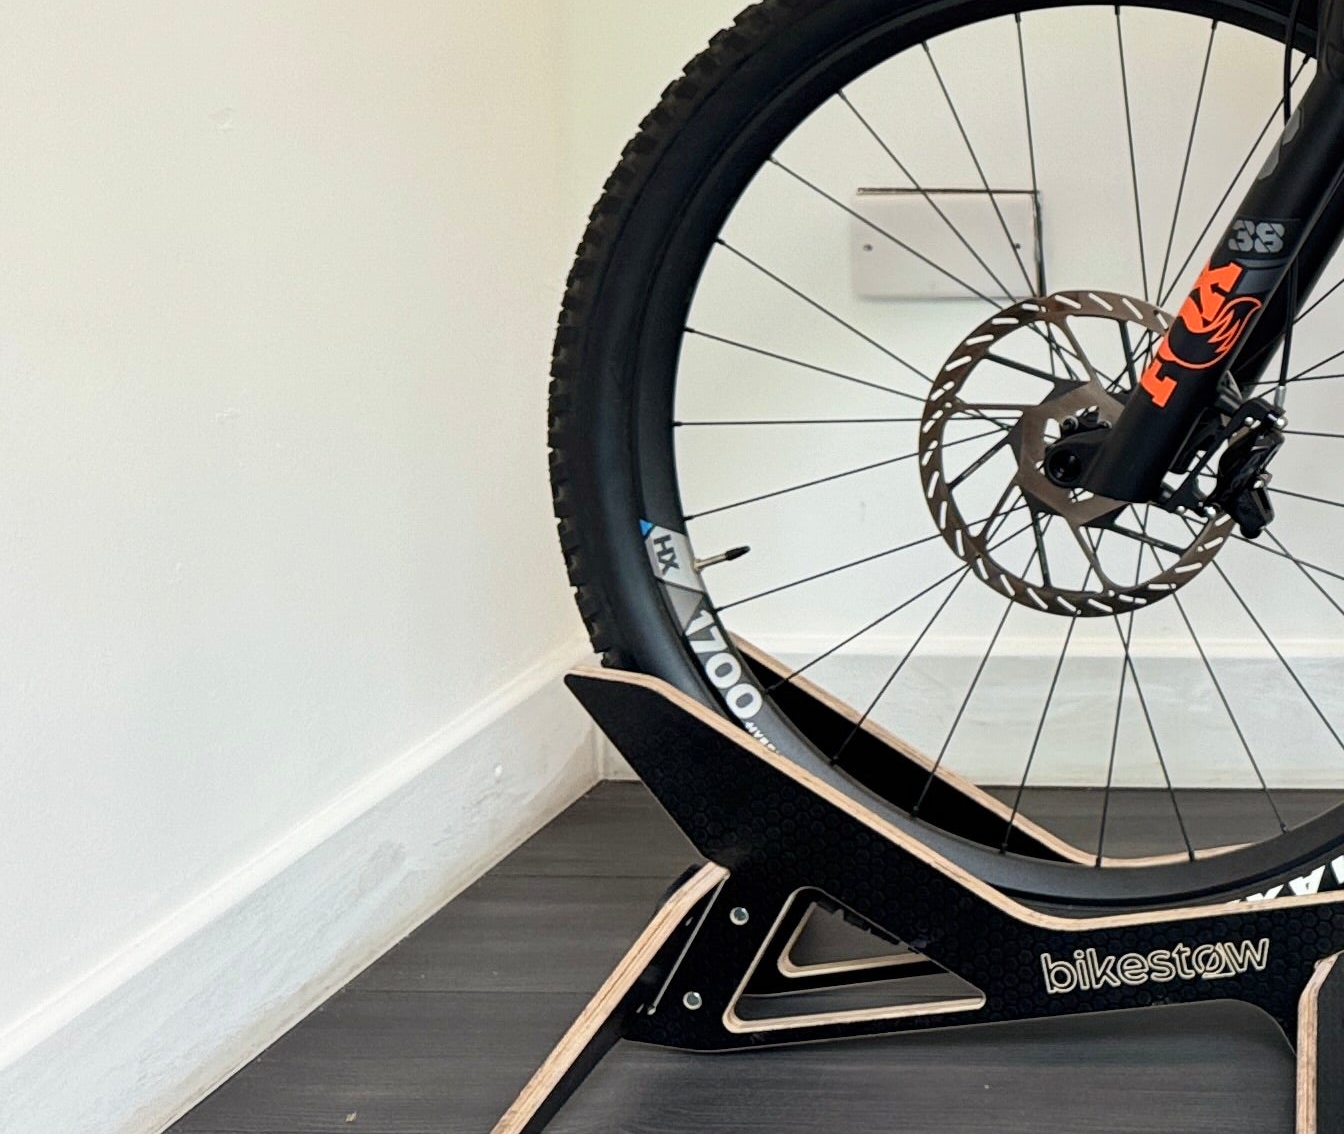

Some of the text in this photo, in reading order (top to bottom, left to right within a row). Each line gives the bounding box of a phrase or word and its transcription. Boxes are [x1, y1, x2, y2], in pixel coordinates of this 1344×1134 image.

[1228, 220, 1285, 253] 38
[653, 535, 679, 575] HX
[685, 609, 763, 719] 1700
